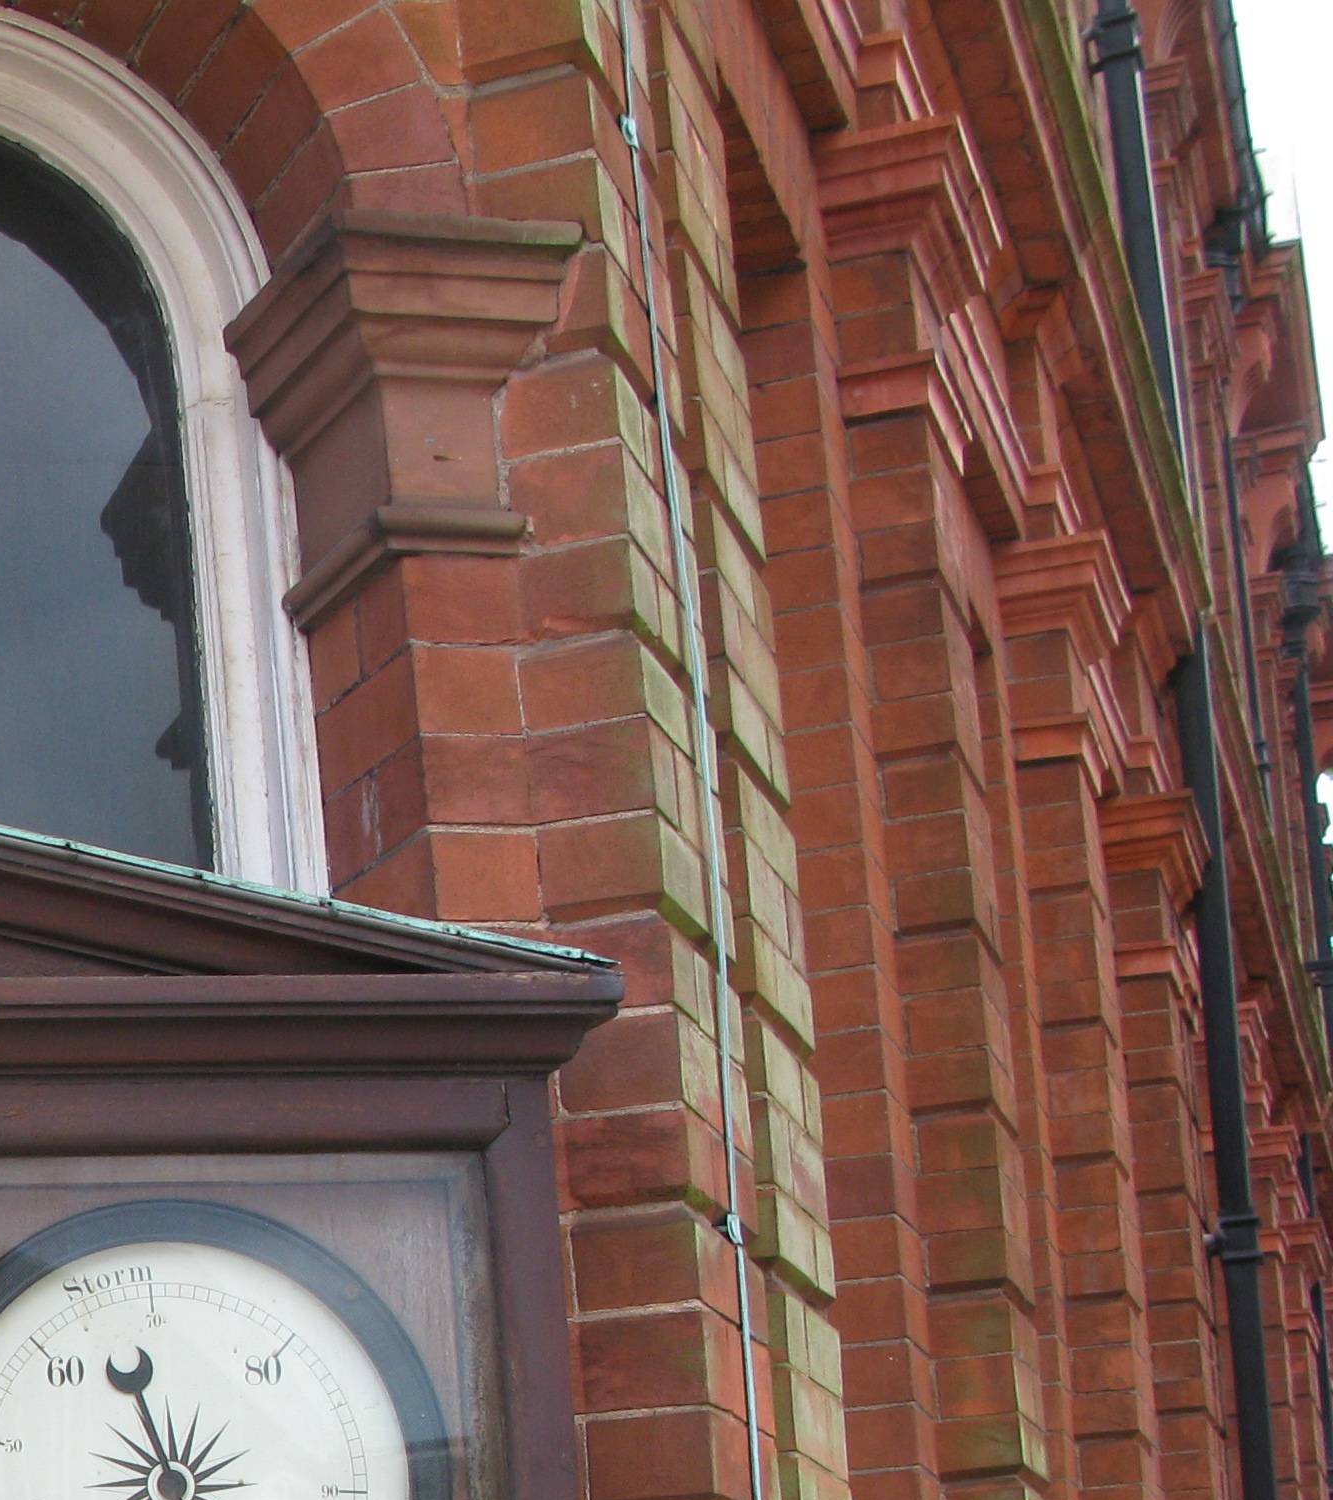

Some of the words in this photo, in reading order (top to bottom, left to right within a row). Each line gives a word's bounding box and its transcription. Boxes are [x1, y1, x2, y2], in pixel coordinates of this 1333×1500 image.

[62, 1265, 154, 1303] Storm
[145, 1313, 162, 1328] 70
[47, 1356, 84, 1387] 60
[244, 1356, 282, 1386] 80
[4, 1439, 23, 1453] 50
[321, 1484, 339, 1499] 90
